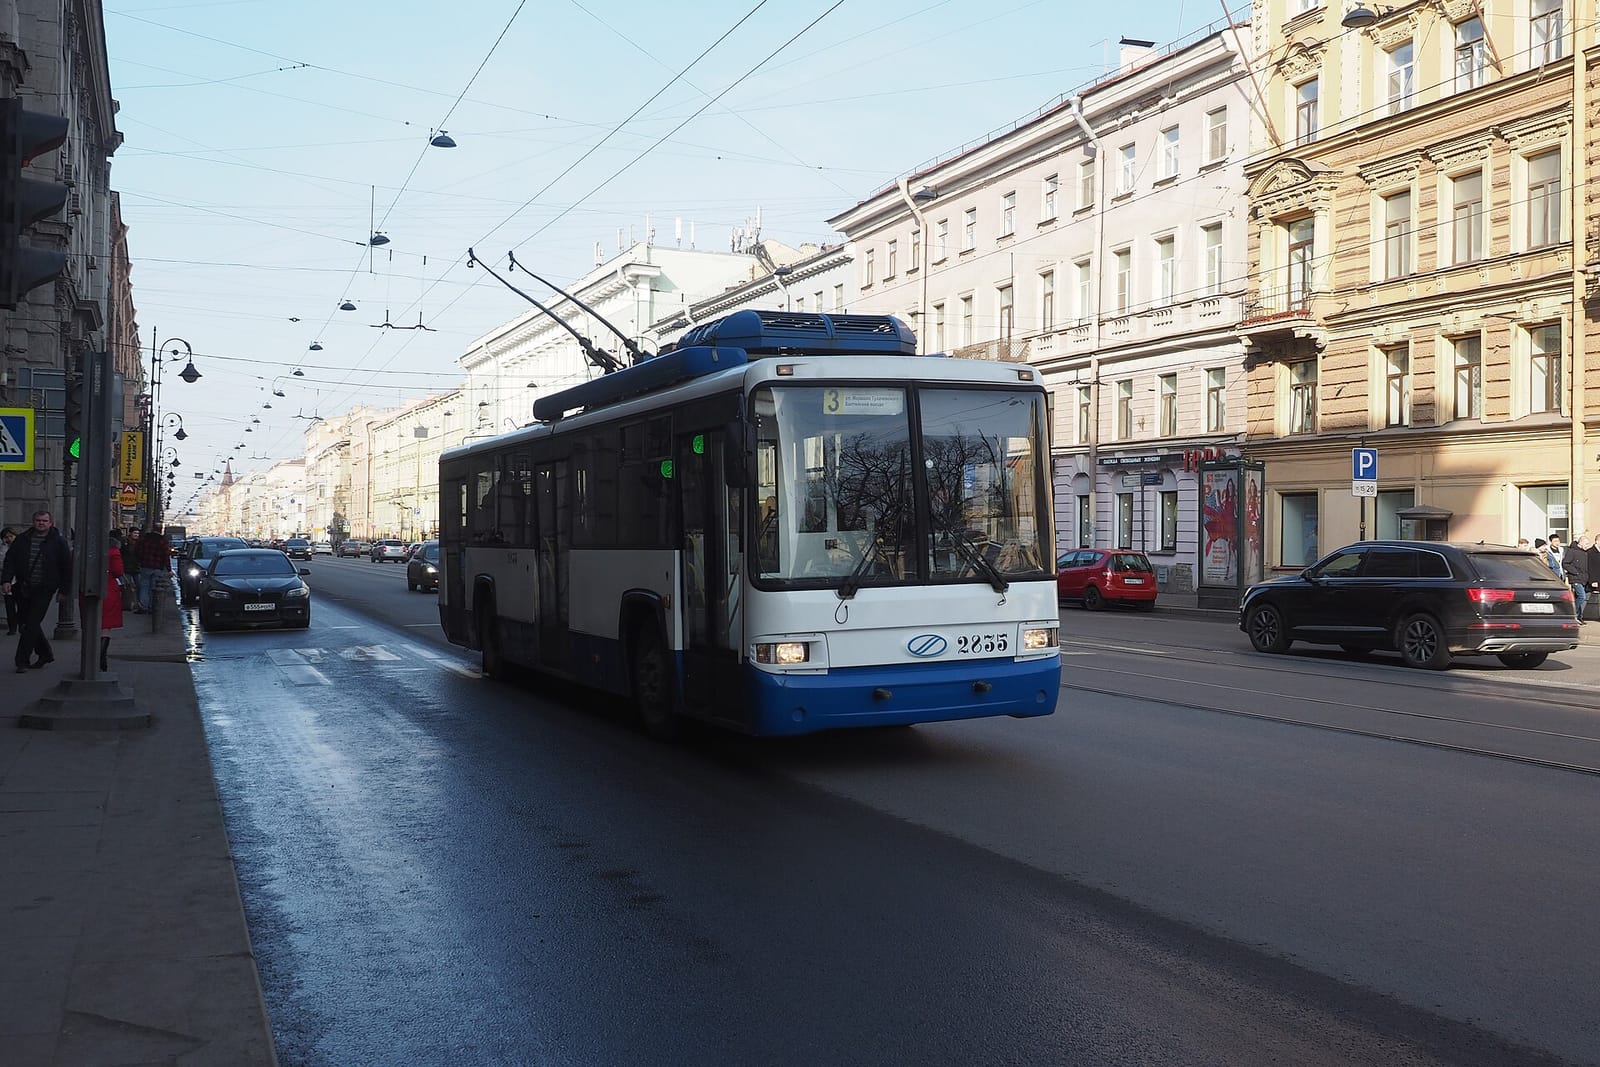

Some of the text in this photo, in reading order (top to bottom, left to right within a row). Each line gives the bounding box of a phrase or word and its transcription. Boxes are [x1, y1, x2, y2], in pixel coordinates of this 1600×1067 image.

[828, 390, 839, 412] 3
[1359, 452, 1373, 477] P
[957, 633, 1008, 655] 2835
